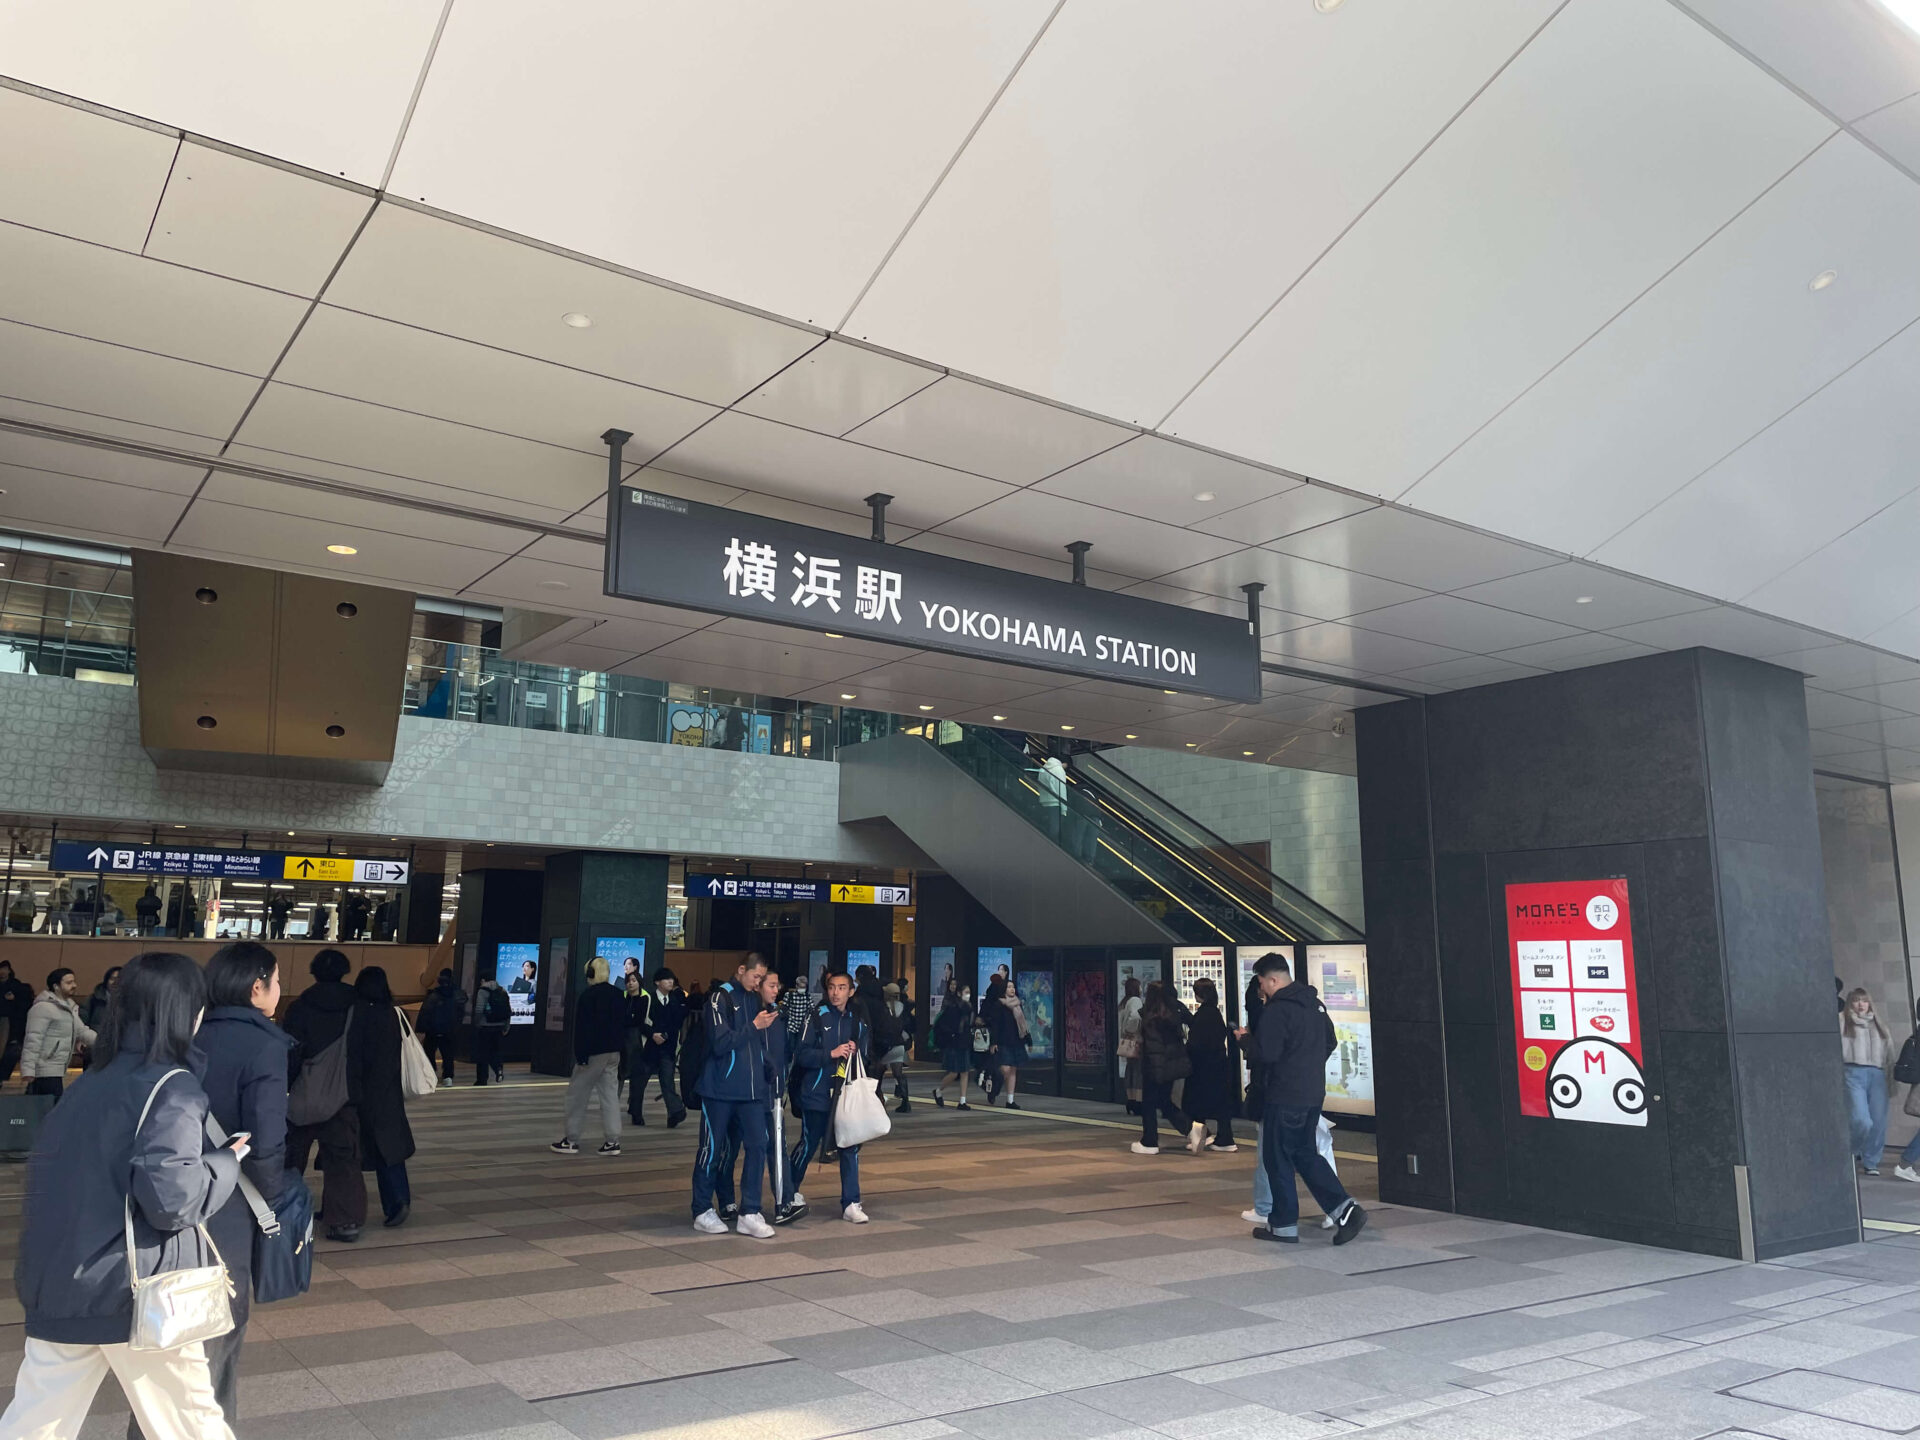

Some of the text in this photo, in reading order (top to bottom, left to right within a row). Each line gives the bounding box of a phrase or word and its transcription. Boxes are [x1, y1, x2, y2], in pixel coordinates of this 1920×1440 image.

[723, 537, 902, 624] 横浜駅
[919, 600, 1197, 676] YOKOHAMA STATION
[138, 851, 161, 859] JR線
[165, 852, 190, 860] 京急線
[1516, 903, 1579, 918] MORE'S
[1594, 905, 1610, 913] 西口
[1595, 914, 1610, 922] すぐ
[1584, 1049, 1606, 1075] M
